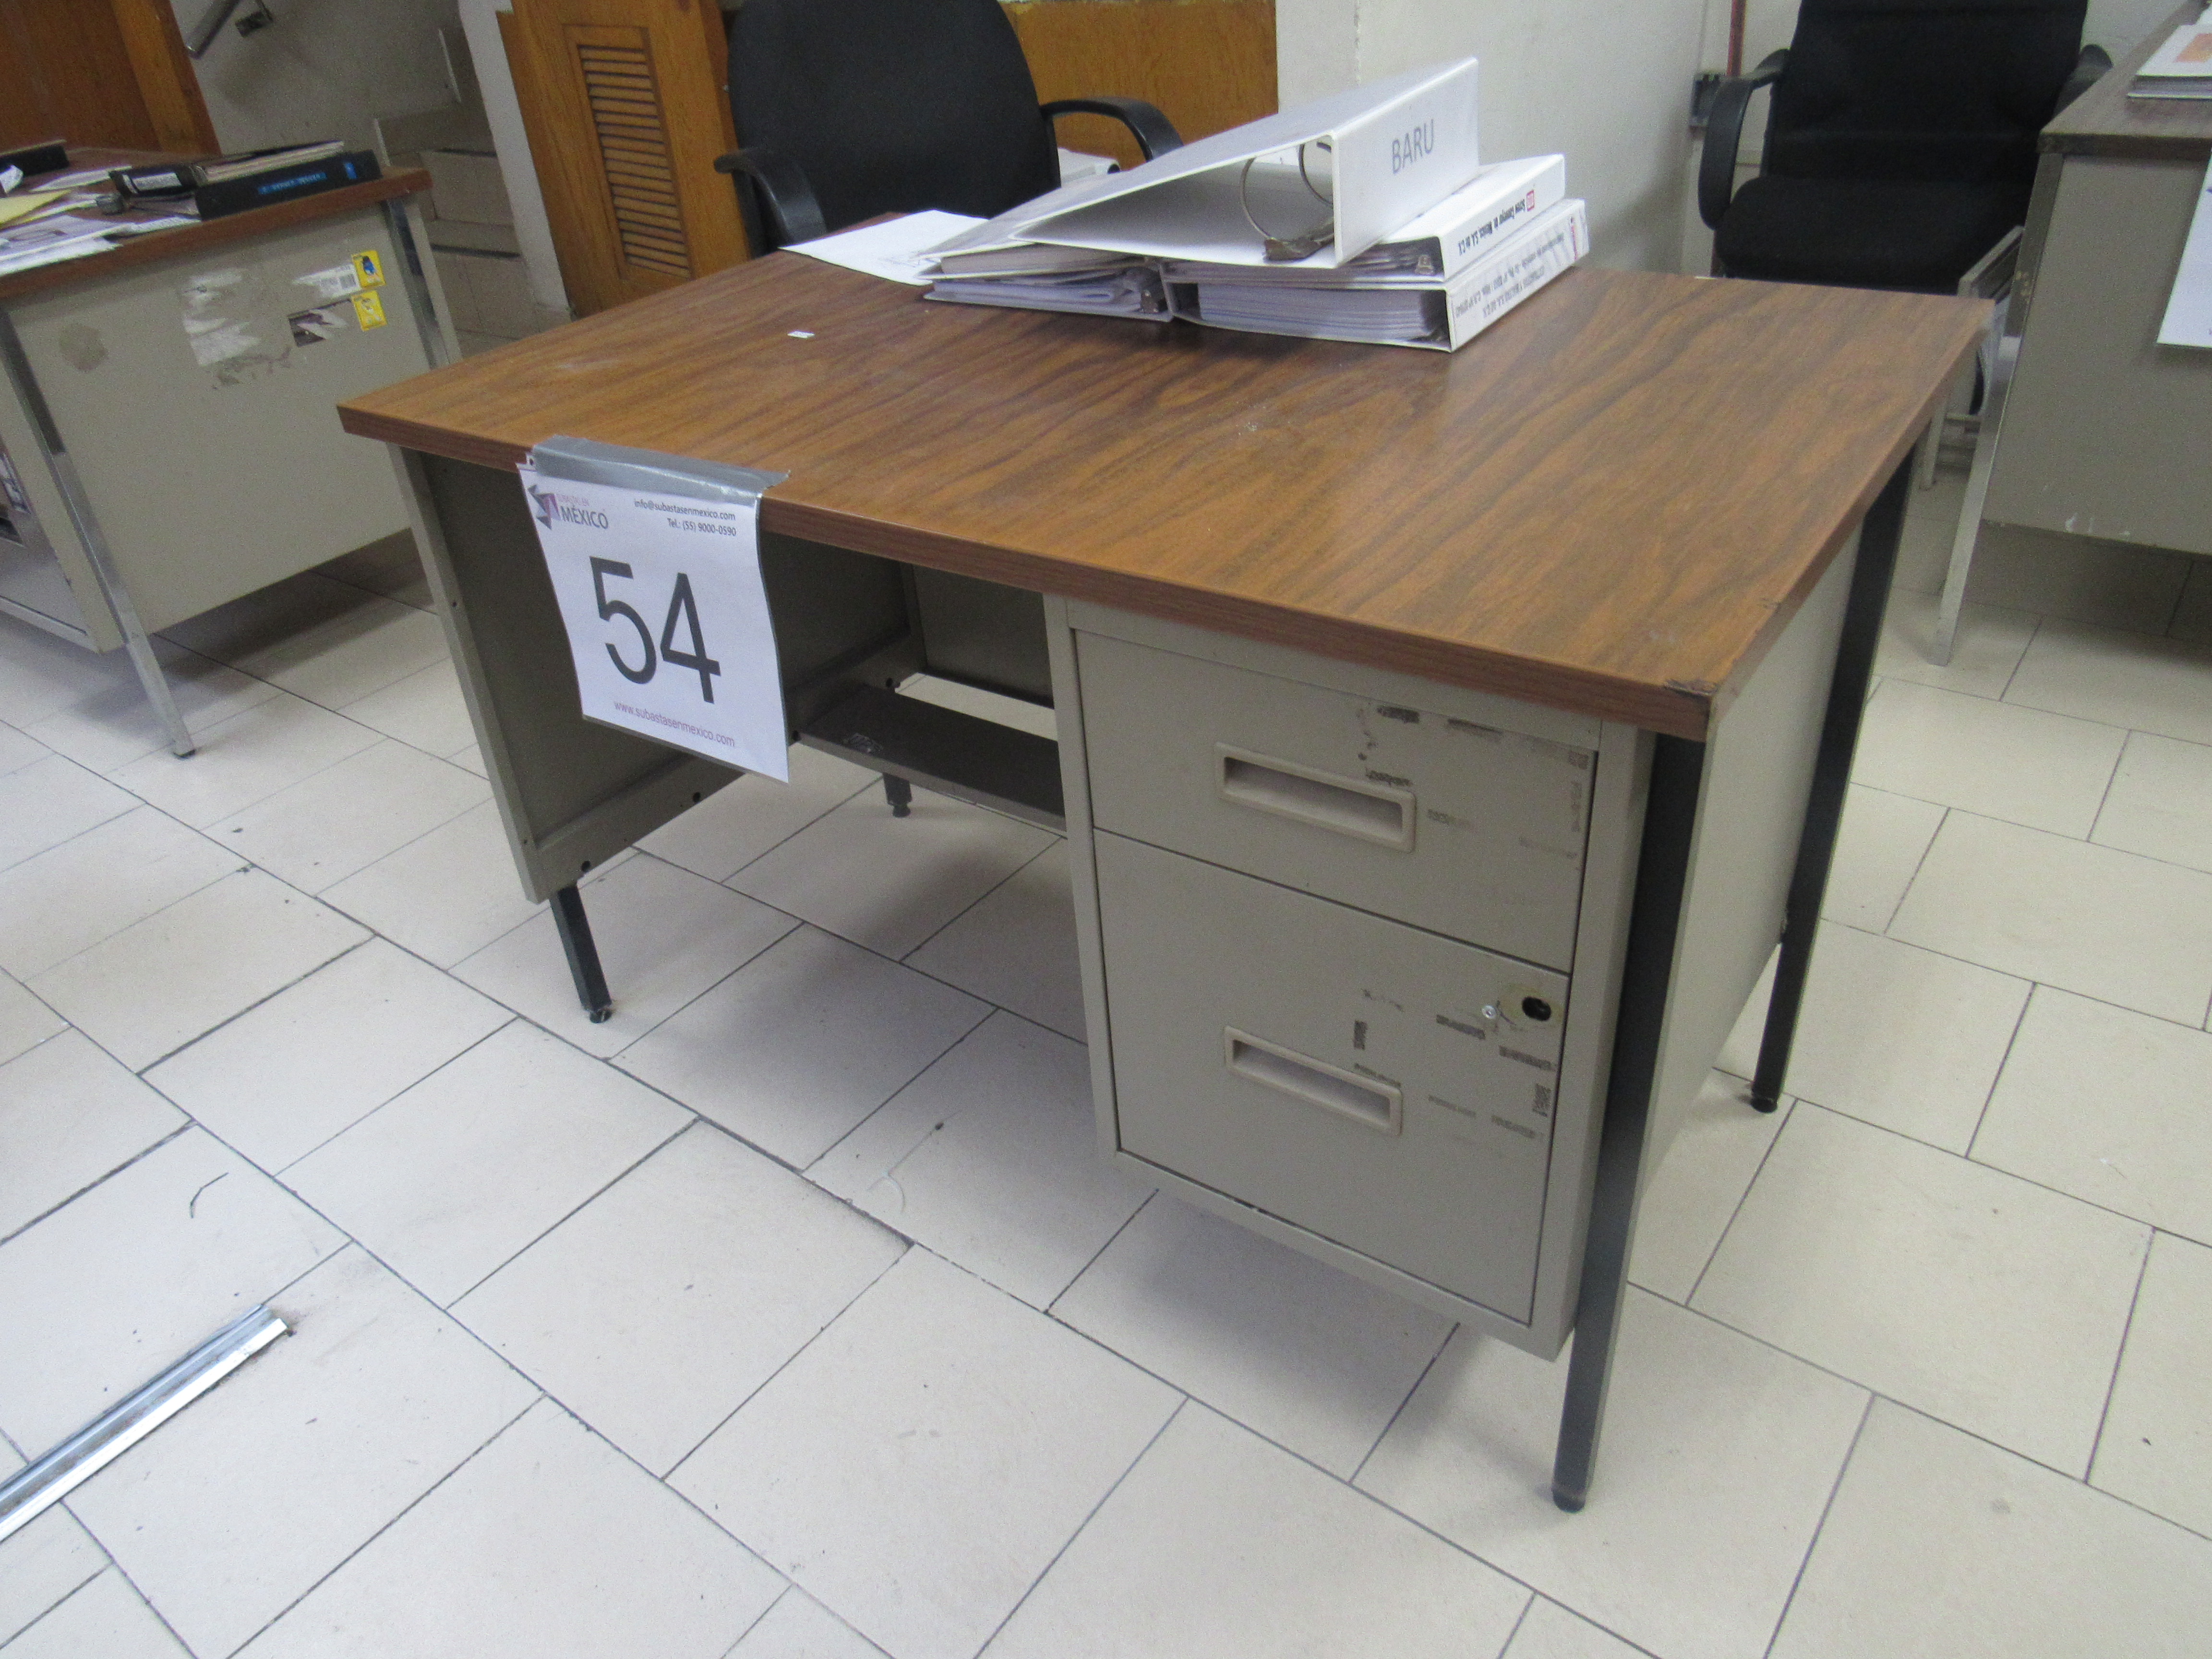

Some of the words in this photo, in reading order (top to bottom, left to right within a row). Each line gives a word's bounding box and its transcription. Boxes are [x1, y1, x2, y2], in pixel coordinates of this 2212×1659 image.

[1392, 119, 1433, 174] BARU
[560, 505, 609, 529] MÉXICO
[634, 498, 736, 521] info@subastasenmexico.com
[683, 520, 696, 532] (55)
[697, 522, 736, 537] 9000-0590
[589, 556, 721, 704] 54
[614, 701, 735, 747] www.subastasenmexico.com
